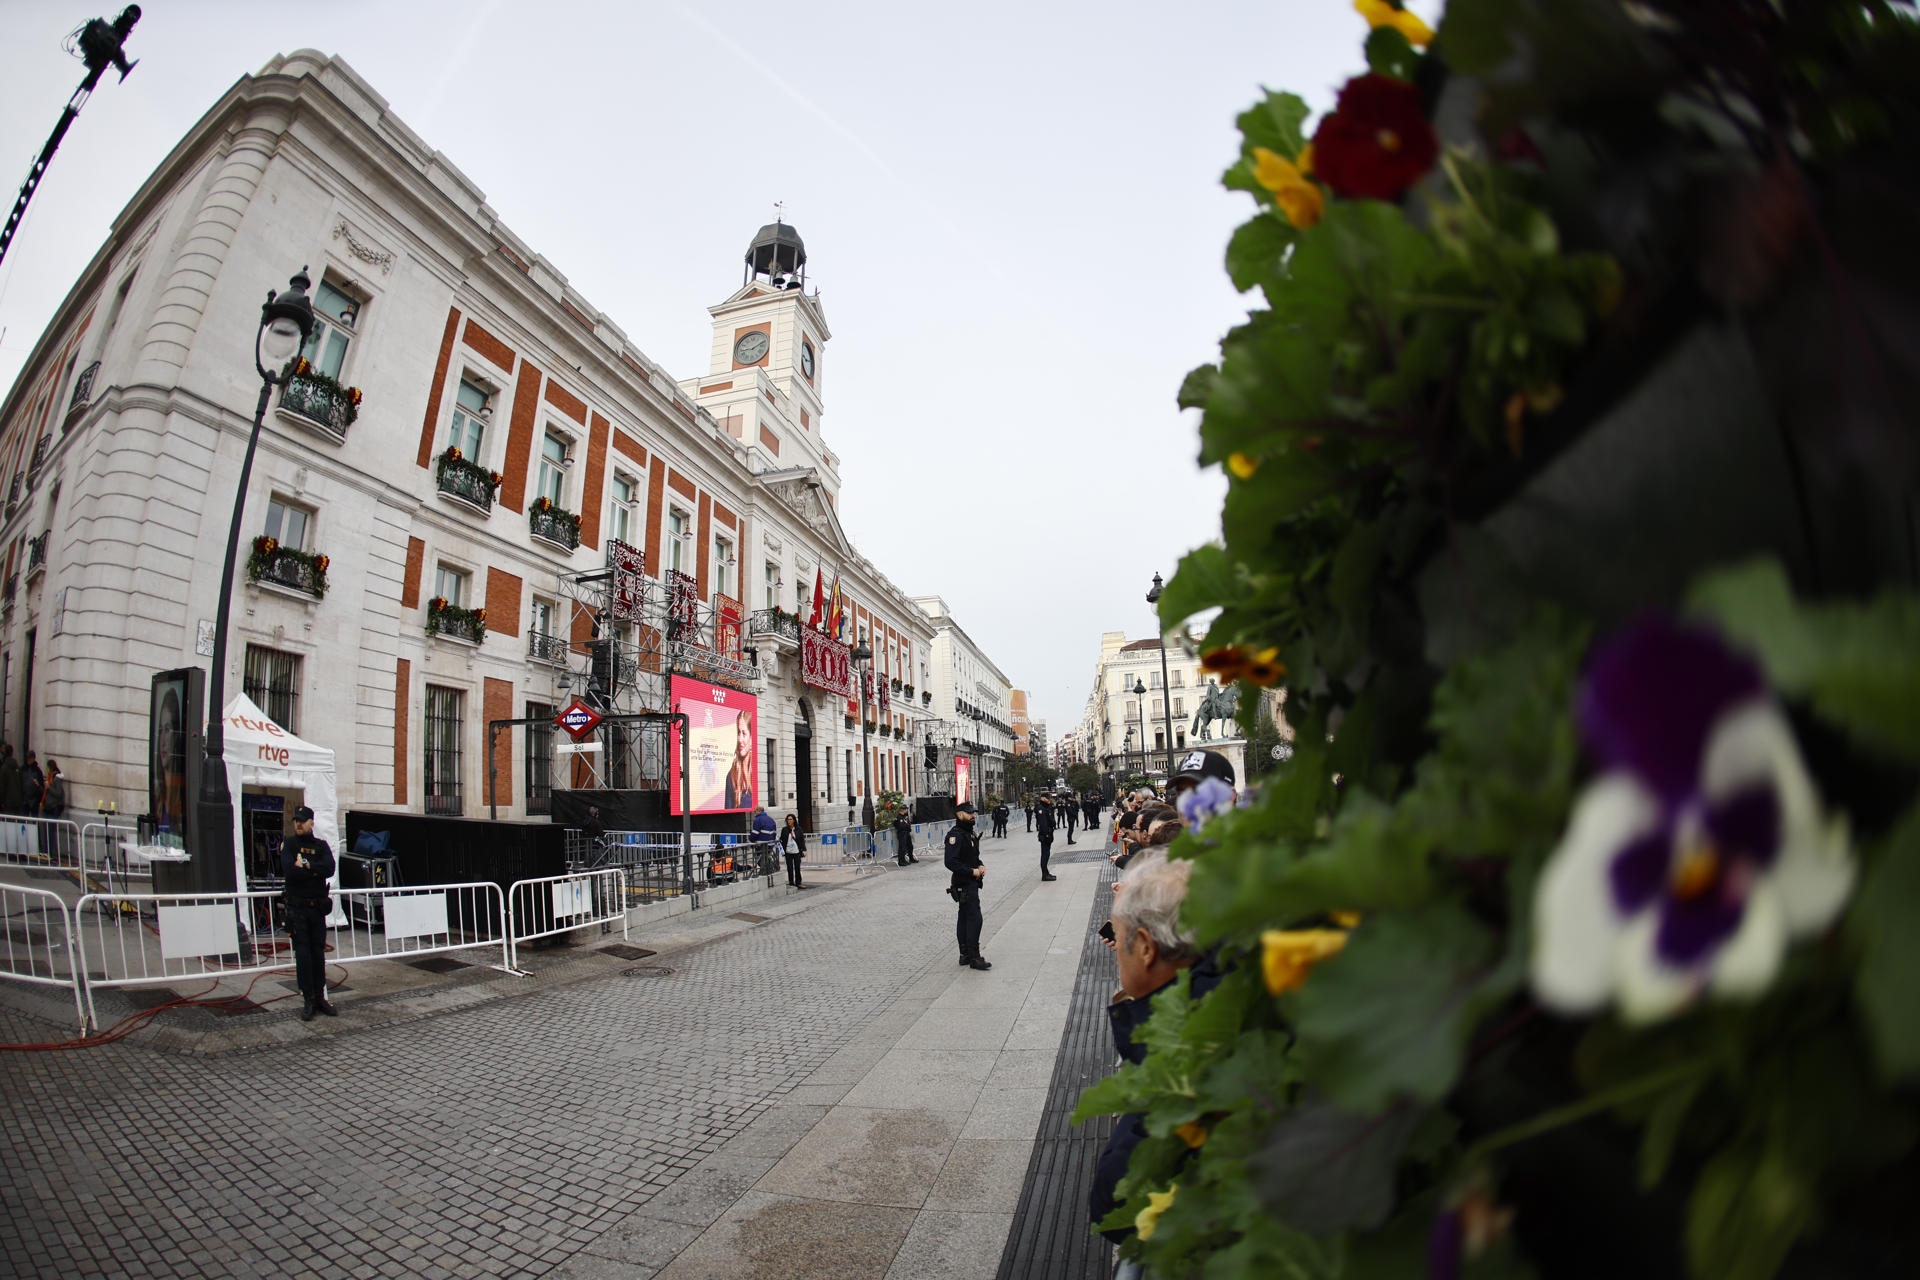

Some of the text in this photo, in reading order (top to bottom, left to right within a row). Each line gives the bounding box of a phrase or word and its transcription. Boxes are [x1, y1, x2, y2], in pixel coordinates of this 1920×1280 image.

[230, 715, 285, 738] rtve
[566, 715, 587, 723] Metro
[258, 743, 290, 767] rtve
